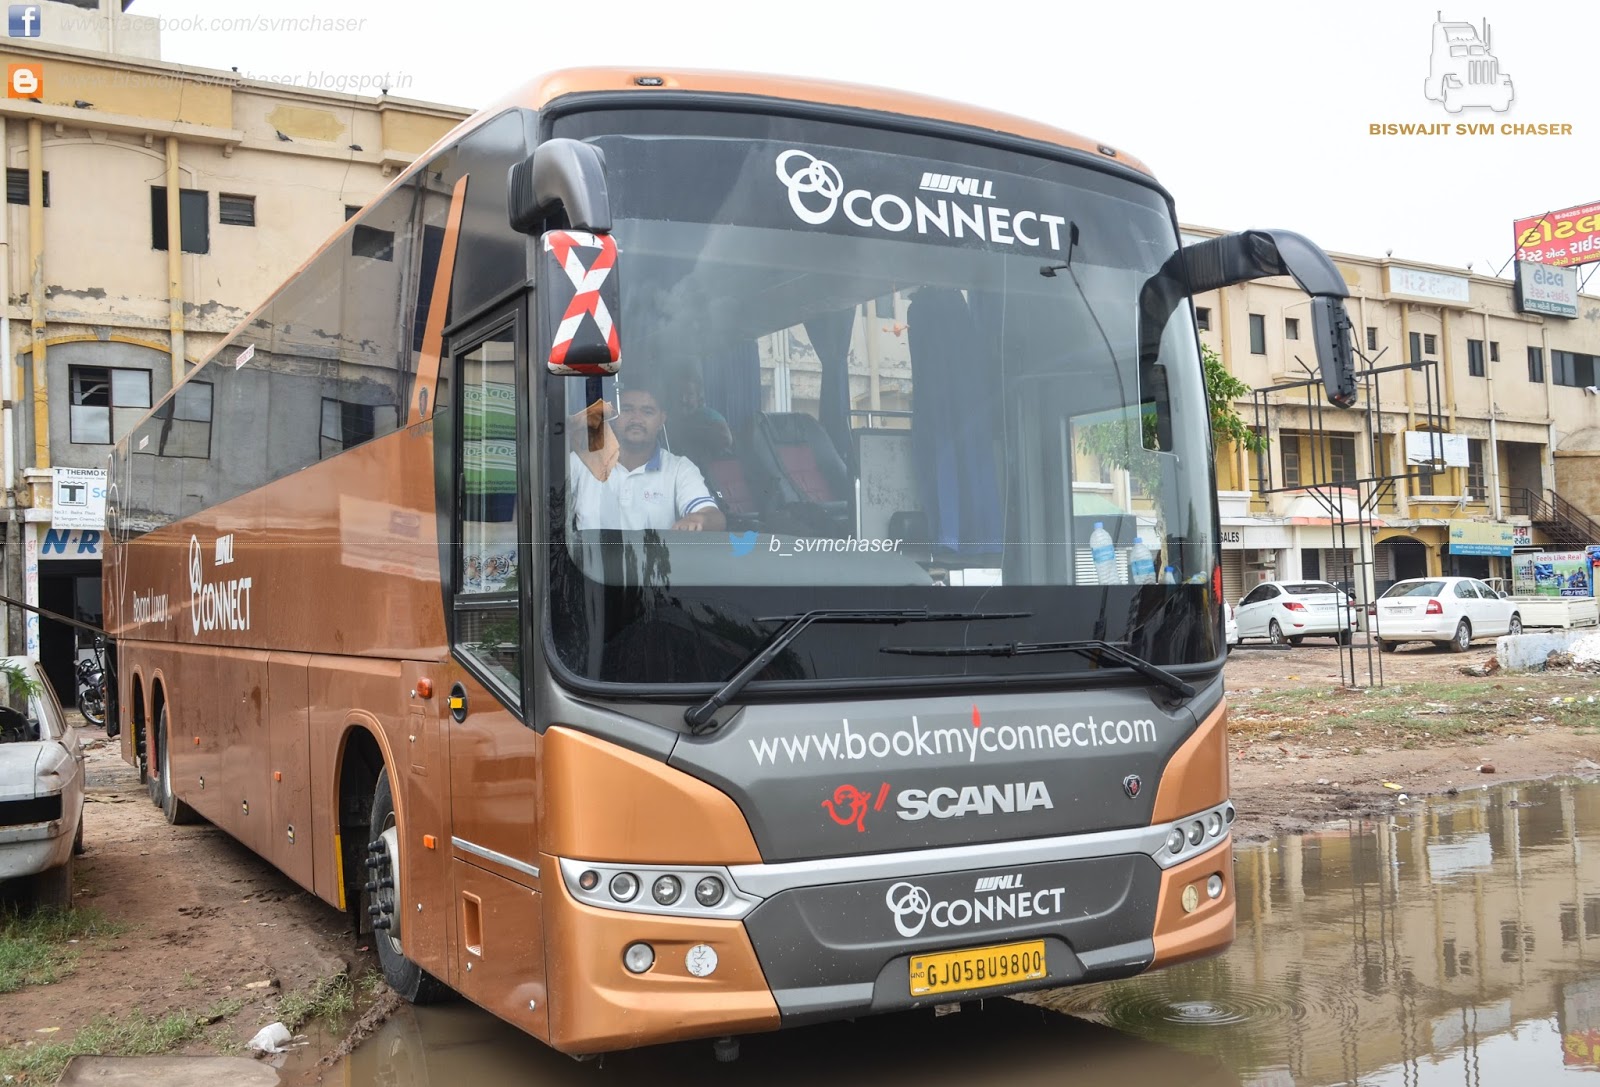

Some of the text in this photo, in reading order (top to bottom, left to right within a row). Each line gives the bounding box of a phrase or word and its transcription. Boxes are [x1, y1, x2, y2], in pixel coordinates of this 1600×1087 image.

[843, 189, 1066, 250] CONNECT
[1517, 213, 1600, 248] હોટલ
[1534, 264, 1564, 287] હોટલ
[1221, 531, 1240, 543] SALES
[202, 577, 252, 631] CONNECT
[748, 714, 1157, 766] www.bookmyconnect.com
[896, 780, 1054, 821] SCANIA
[931, 887, 1066, 928] CONNECT
[927, 950, 1041, 986] GJ05BU9800
